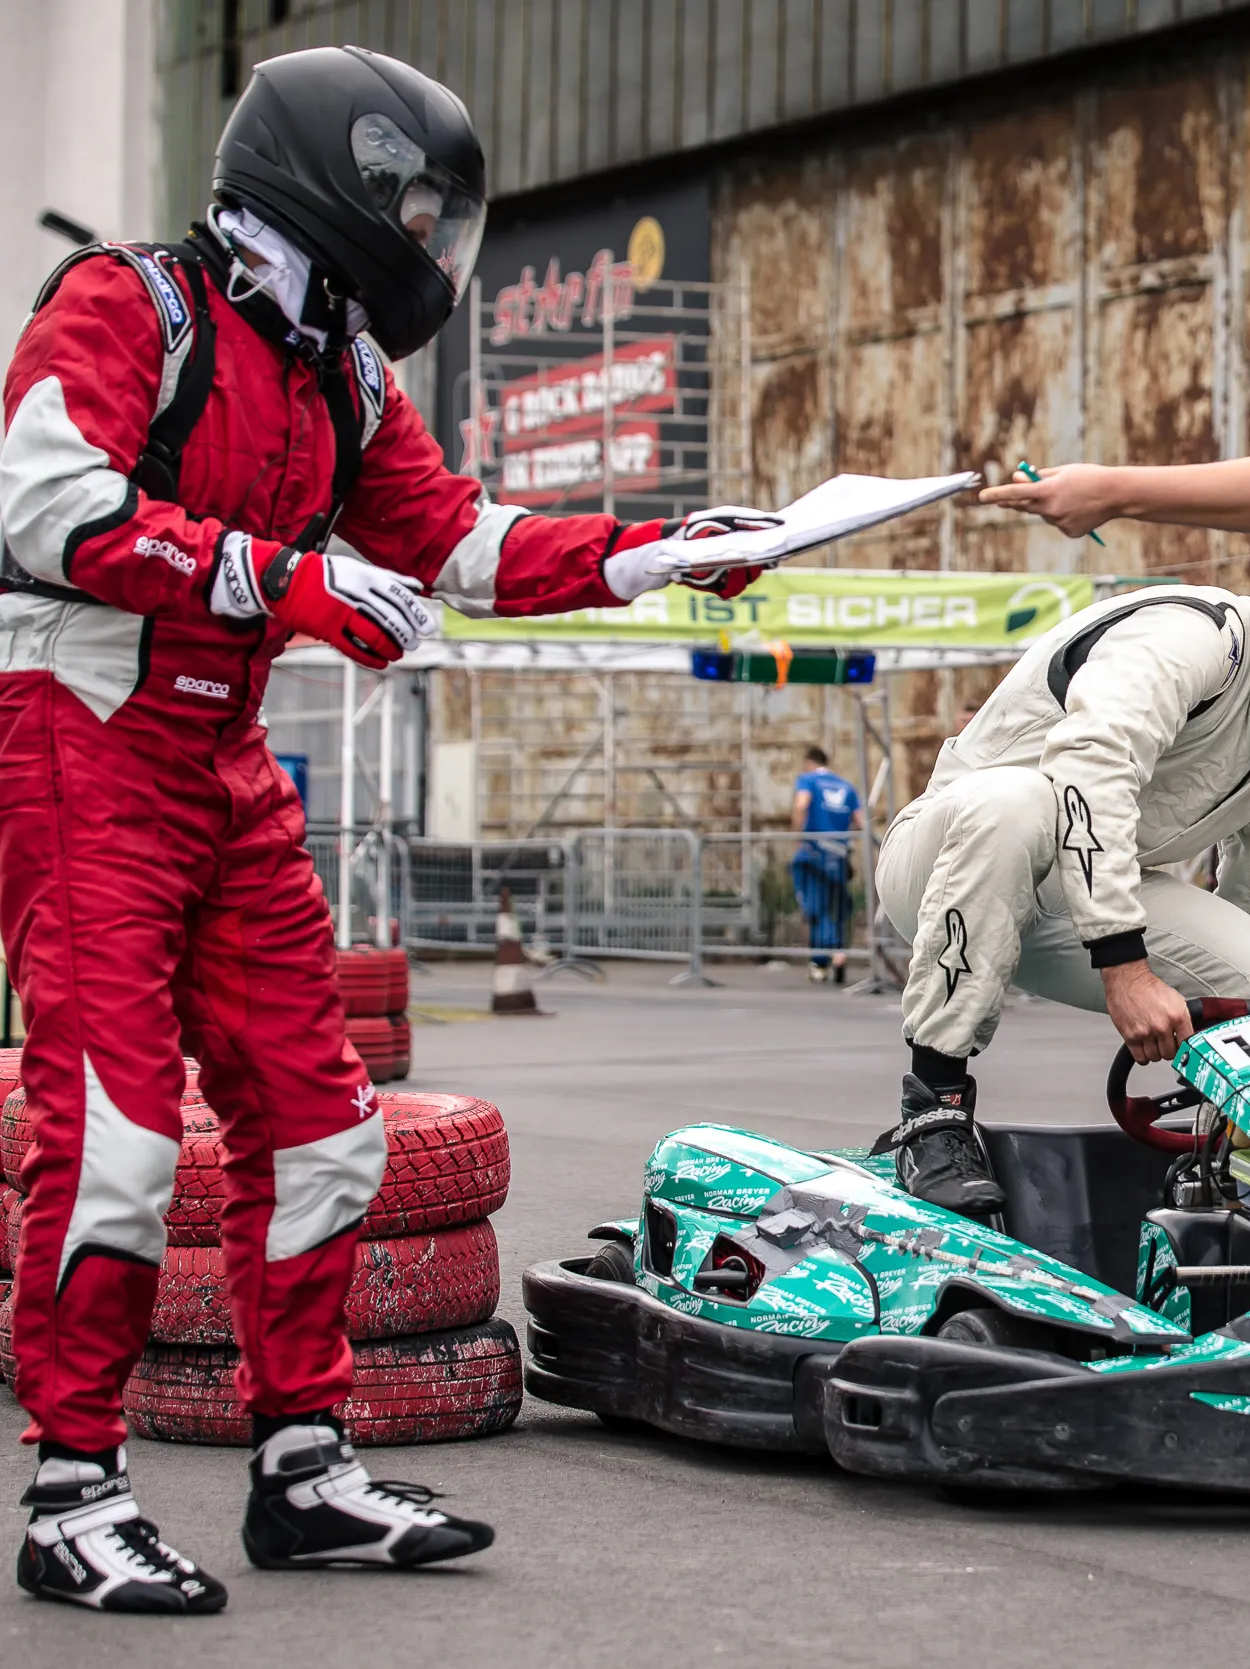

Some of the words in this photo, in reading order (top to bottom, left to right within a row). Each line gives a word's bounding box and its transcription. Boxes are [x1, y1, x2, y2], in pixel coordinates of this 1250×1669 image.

[141, 255, 183, 324] sparco
[132, 535, 197, 576] sparco
[222, 551, 248, 605] sparco
[688, 594, 768, 623] IST
[786, 593, 978, 628] SICHER
[173, 674, 230, 699] sparco
[891, 1107, 968, 1143] alpinestars
[671, 1162, 732, 1184] Racing
[704, 1189, 734, 1198] NORMAN
[736, 1187, 771, 1195] GREYER
[707, 1194, 768, 1214] Racing
[879, 1268, 906, 1278] GREYER
[918, 1263, 950, 1273] NORMAN
[827, 1271, 863, 1291] NORMAN
[904, 1303, 933, 1313] GREYER
[81, 1475, 129, 1500] sparco
[52, 1540, 88, 1586] sparco
